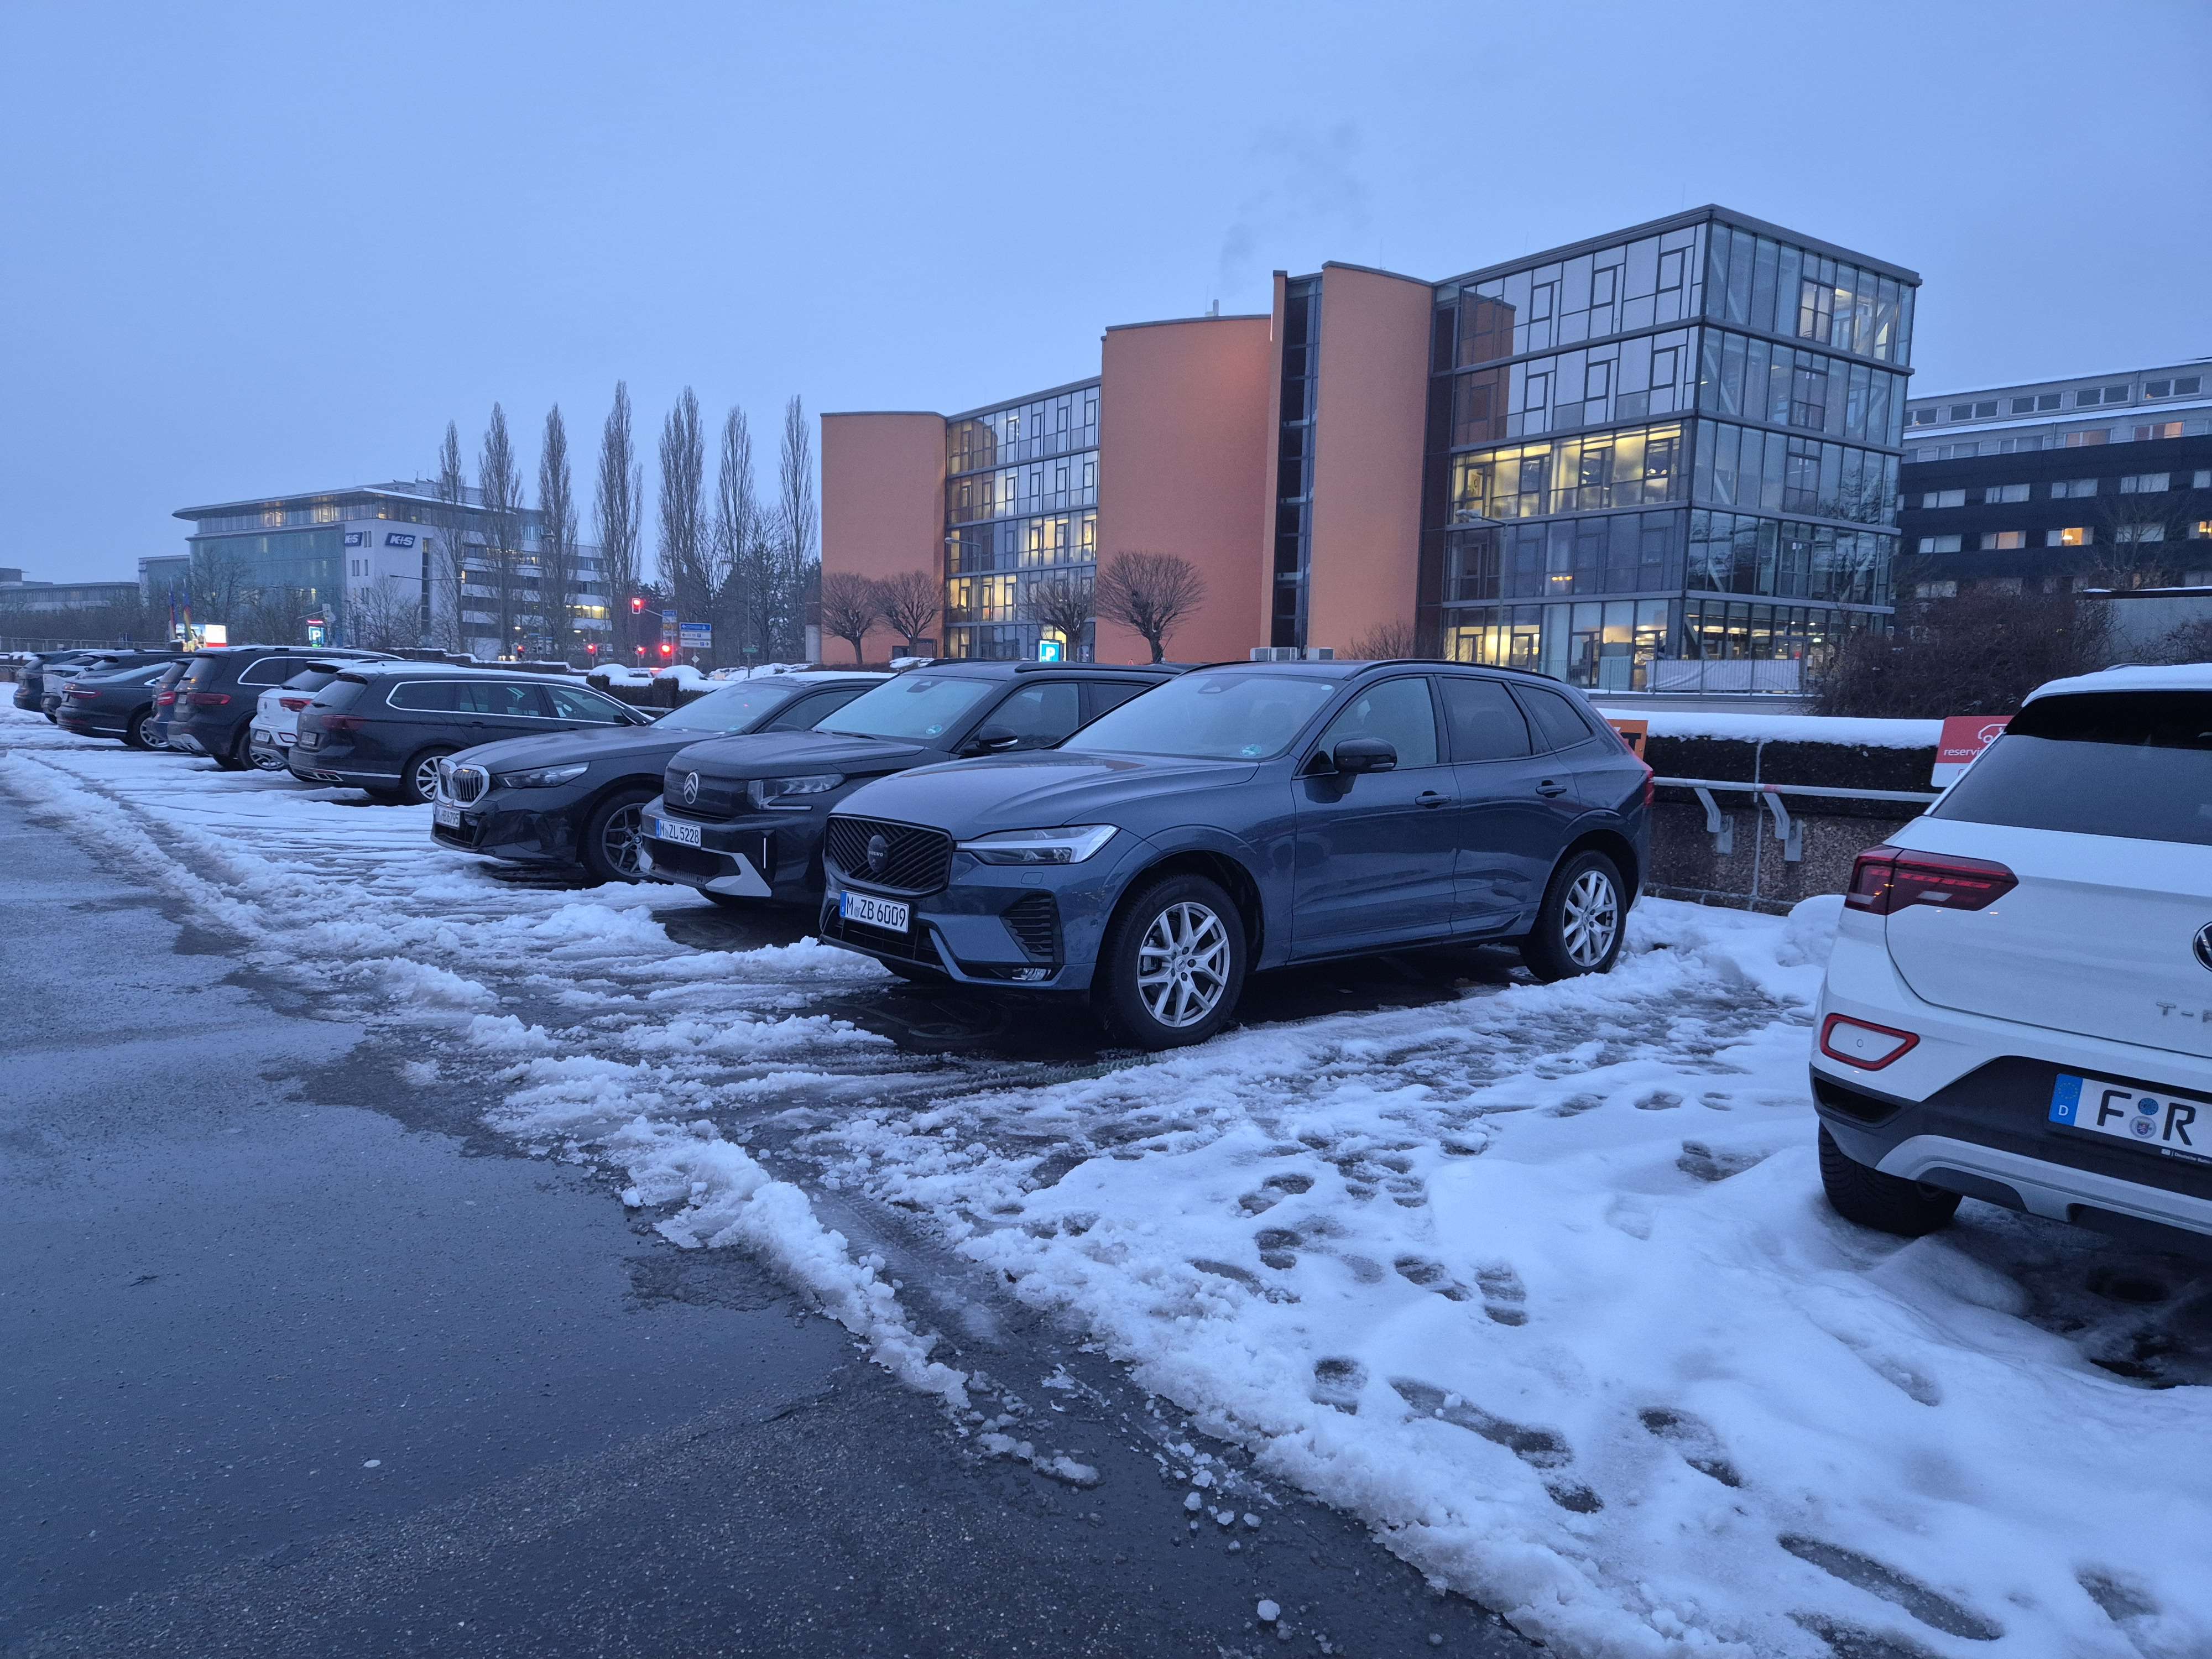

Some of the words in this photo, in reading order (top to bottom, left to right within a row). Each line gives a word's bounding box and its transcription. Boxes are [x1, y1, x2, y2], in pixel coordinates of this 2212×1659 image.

[389, 535, 414, 546] K+S
[312, 630, 321, 640] P
[1046, 646, 1056, 661] P
[1944, 747, 1984, 756] reservi
[660, 822, 665, 837] M
[669, 824, 679, 839] ZL
[680, 826, 699, 844] 5228
[847, 895, 853, 915] M
[860, 899, 874, 920] ZB
[877, 902, 906, 927] 6009
[2058, 1104, 2069, 1116] D
[2096, 1089, 2132, 1127] F
[2162, 1102, 2197, 1146] R
